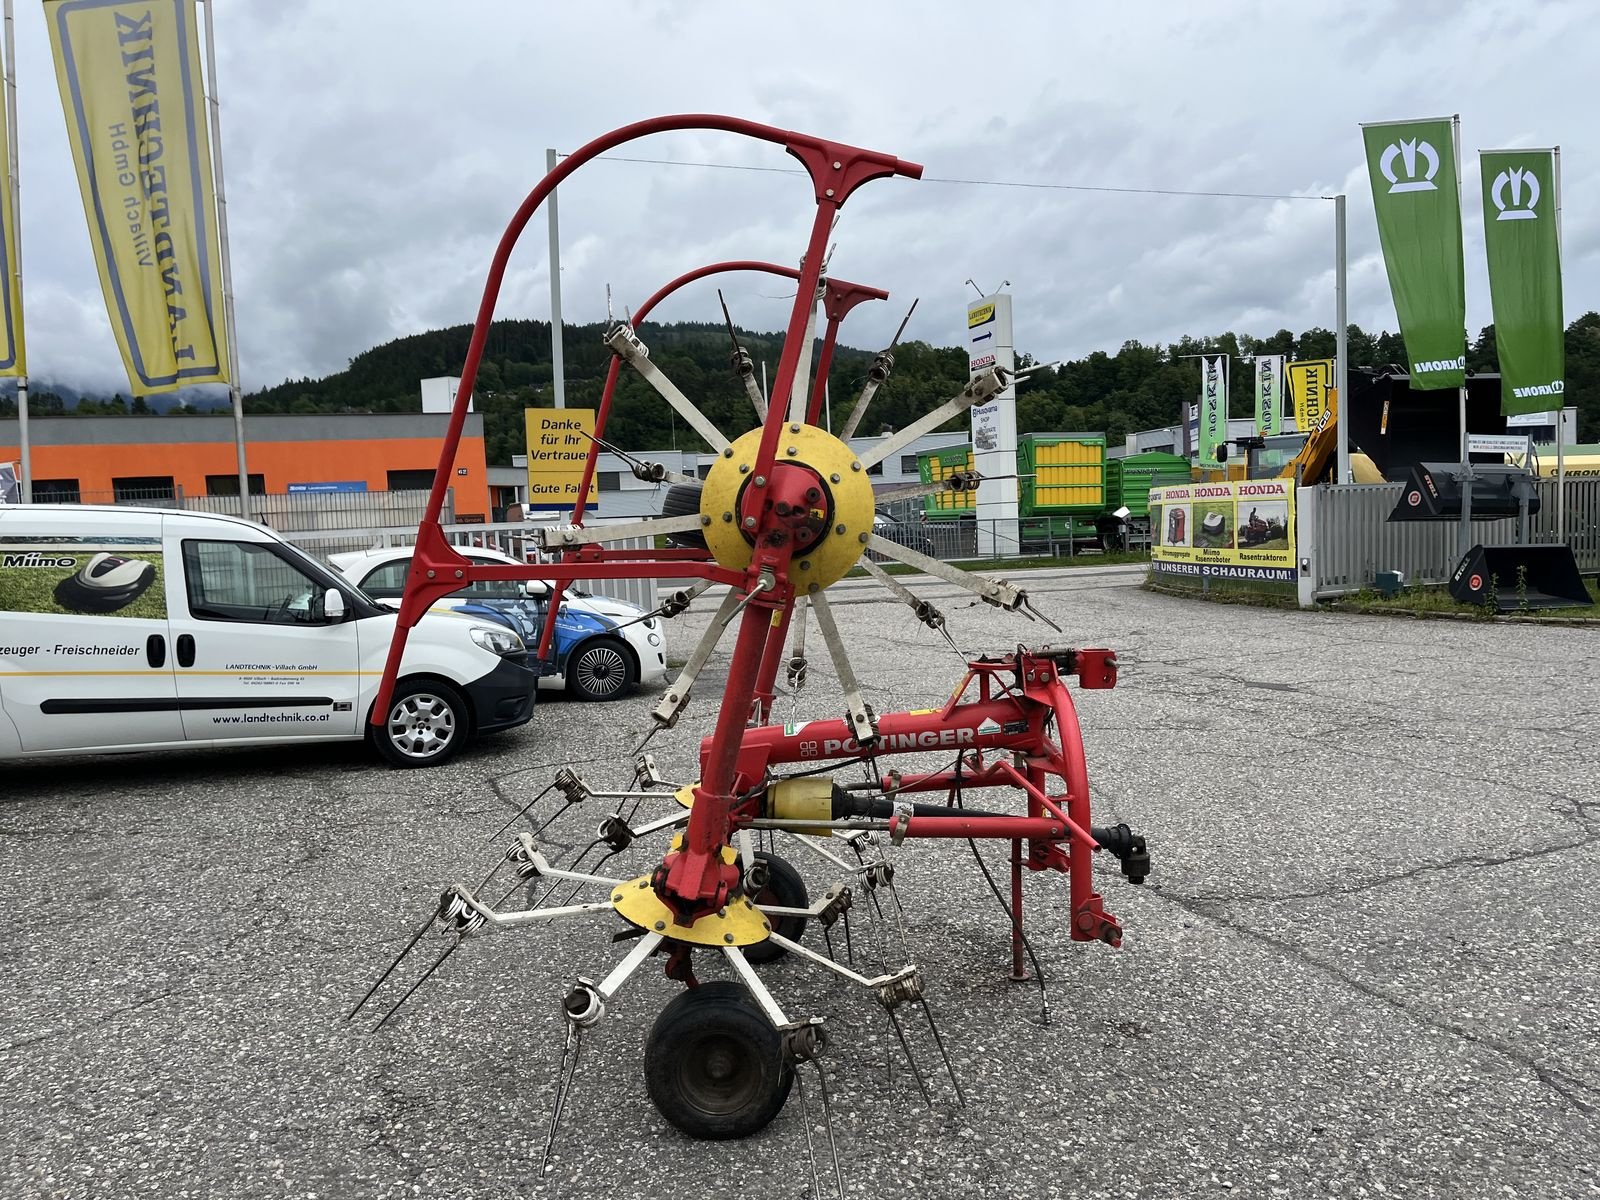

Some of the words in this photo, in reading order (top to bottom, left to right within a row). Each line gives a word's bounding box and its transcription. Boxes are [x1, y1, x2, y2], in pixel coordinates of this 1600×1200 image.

[971, 354, 996, 367] HONDA
[541, 419, 582, 430] Danke
[1317, 409, 1331, 433] JCB
[540, 434, 560, 446] für
[564, 434, 582, 446] Ihr
[531, 450, 590, 461] Vertraue
[532, 483, 560, 494] Gute
[565, 483, 594, 494] Fat
[1194, 487, 1232, 498] HONDA
[1238, 484, 1285, 496] HONDA
[1165, 489, 1191, 500] HONDA
[3, 552, 77, 567] Miimo
[1195, 555, 1231, 564] Rasenroboter
[1239, 553, 1287, 562] Rasentraktoren
[1161, 562, 1200, 575] UNSEREN
[1202, 566, 1292, 580] SCHAURAUM!
[54, 645, 140, 655] Freischneider
[212, 712, 330, 724] www.landtechnik.co.at
